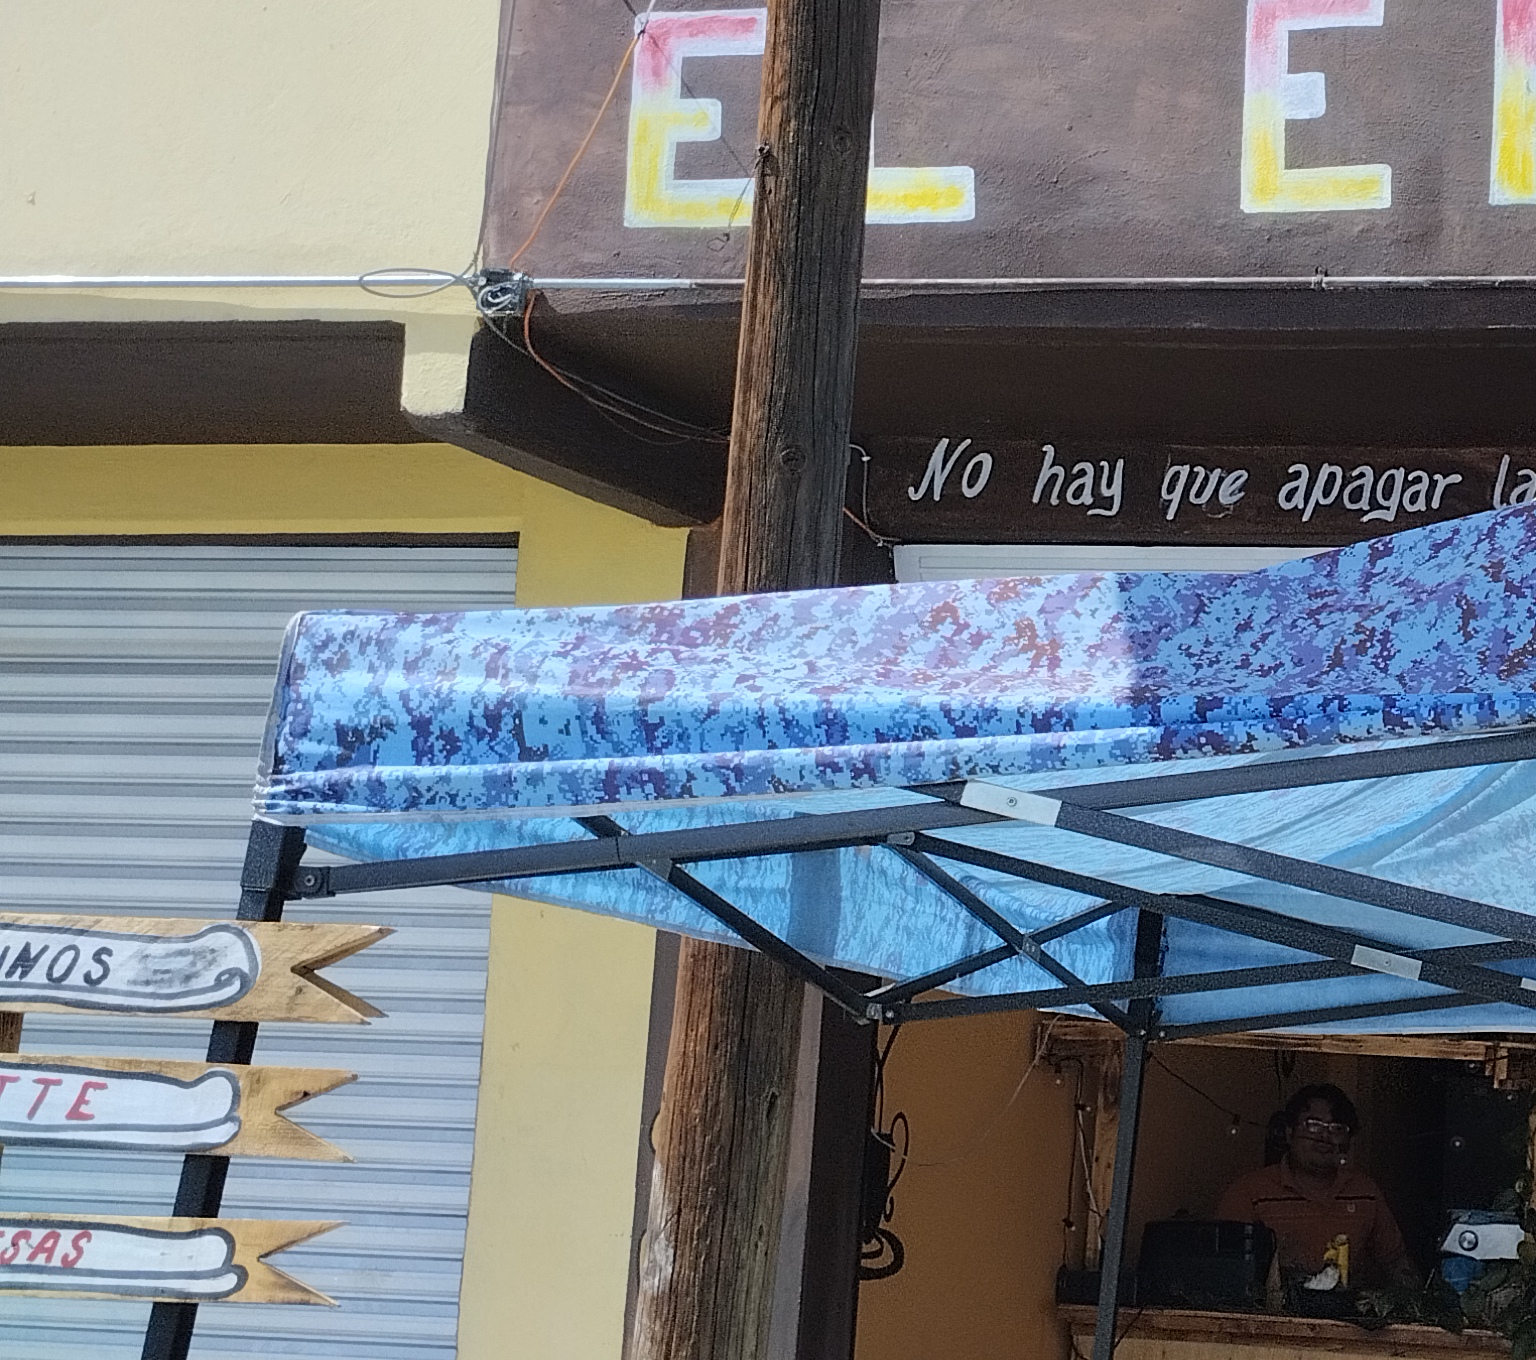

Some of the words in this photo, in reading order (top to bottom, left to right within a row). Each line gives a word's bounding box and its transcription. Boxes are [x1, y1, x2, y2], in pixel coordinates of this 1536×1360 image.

[908, 438, 994, 502] No
[1032, 444, 1124, 516] hay
[1160, 462, 1247, 520] que
[1277, 462, 1463, 523] apagar
[0, 1229, 93, 1269] SAS
